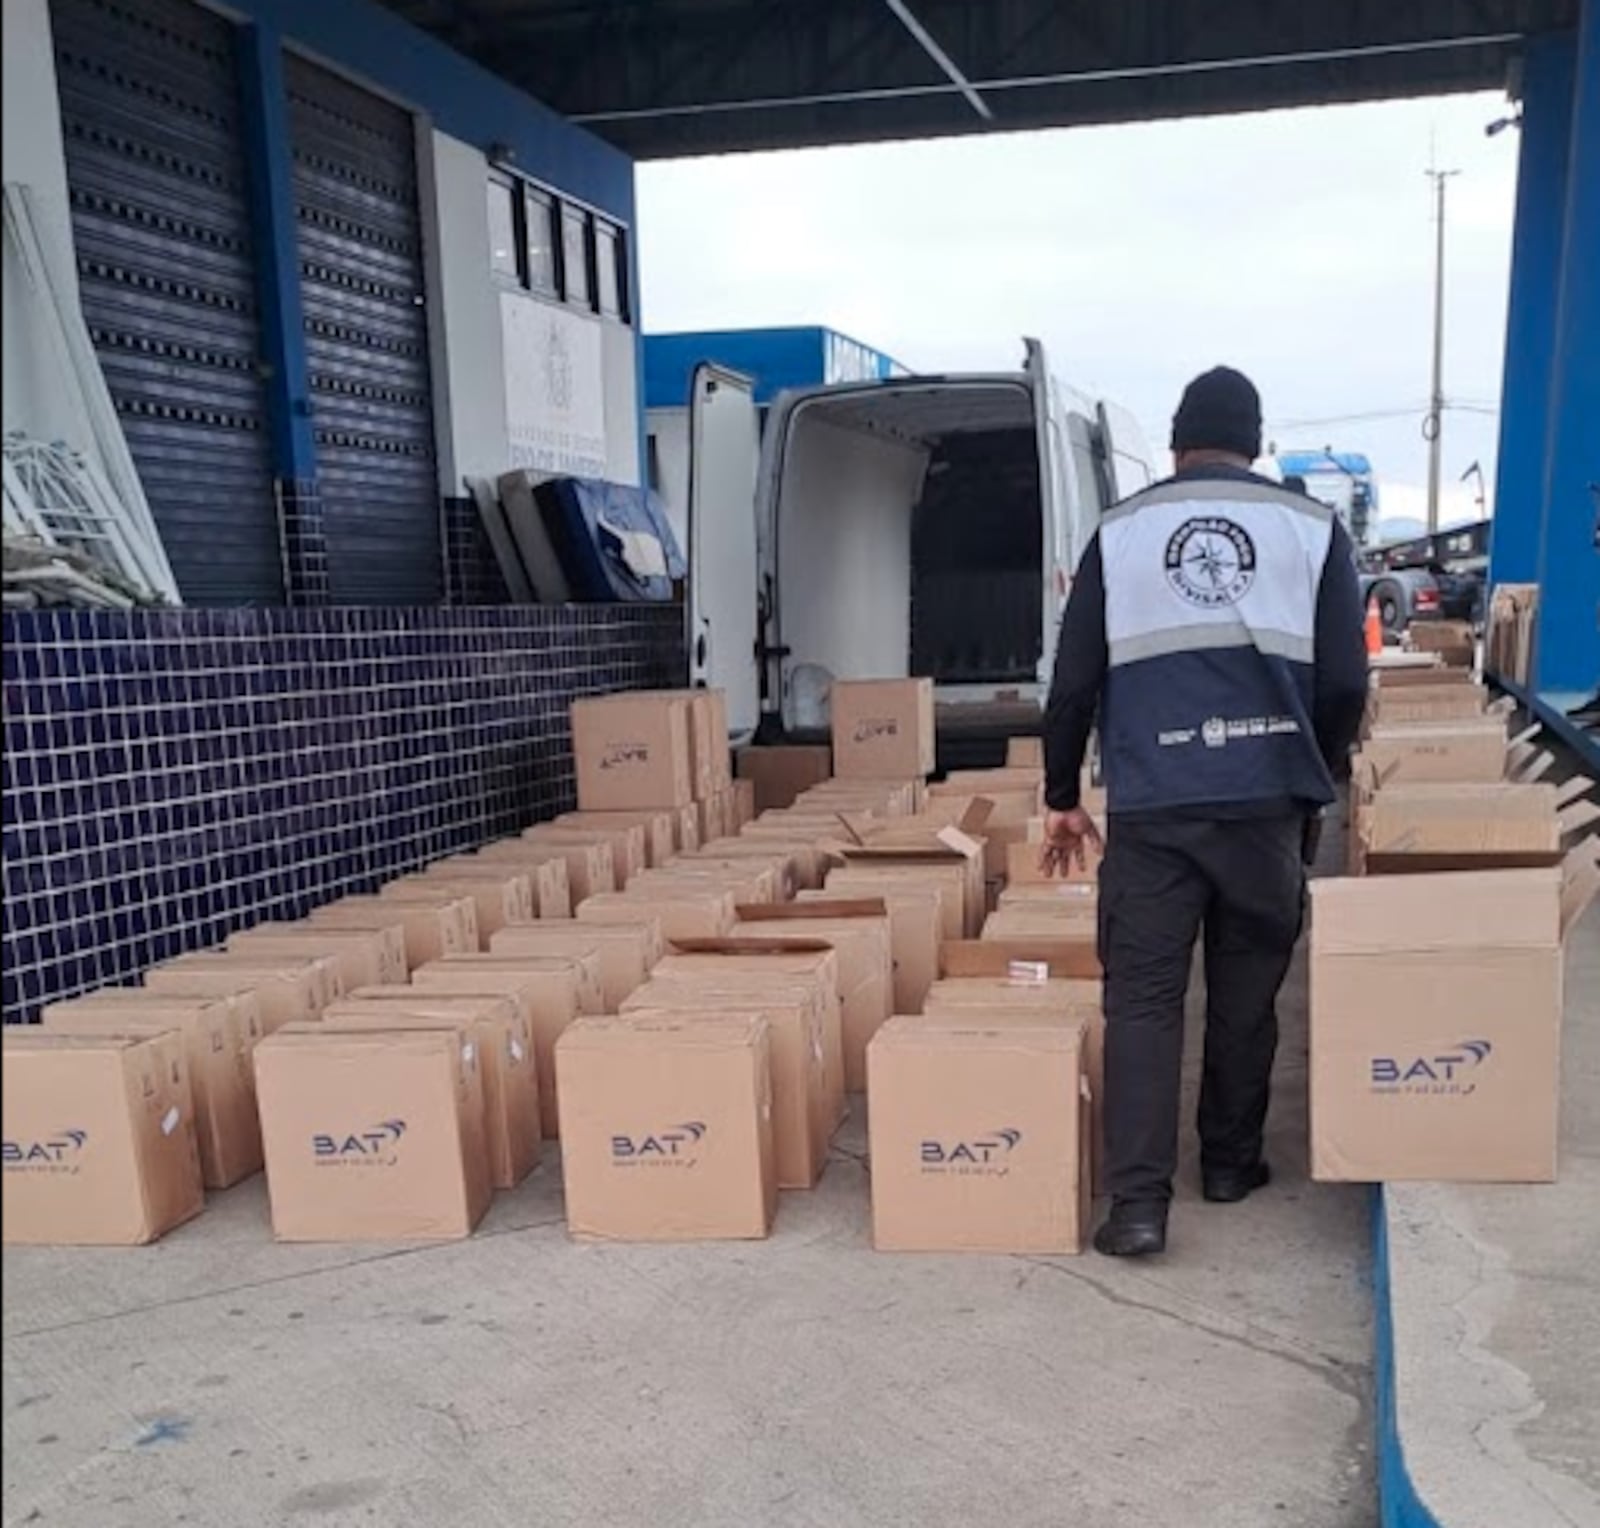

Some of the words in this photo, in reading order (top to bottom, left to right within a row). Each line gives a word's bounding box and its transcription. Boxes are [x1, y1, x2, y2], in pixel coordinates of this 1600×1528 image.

[1372, 1058, 1464, 1081] BAT
[3, 1142, 68, 1161] BAT
[313, 1135, 386, 1154] BAT
[612, 1136, 685, 1156] BAT
[921, 1142, 998, 1162] BAT
